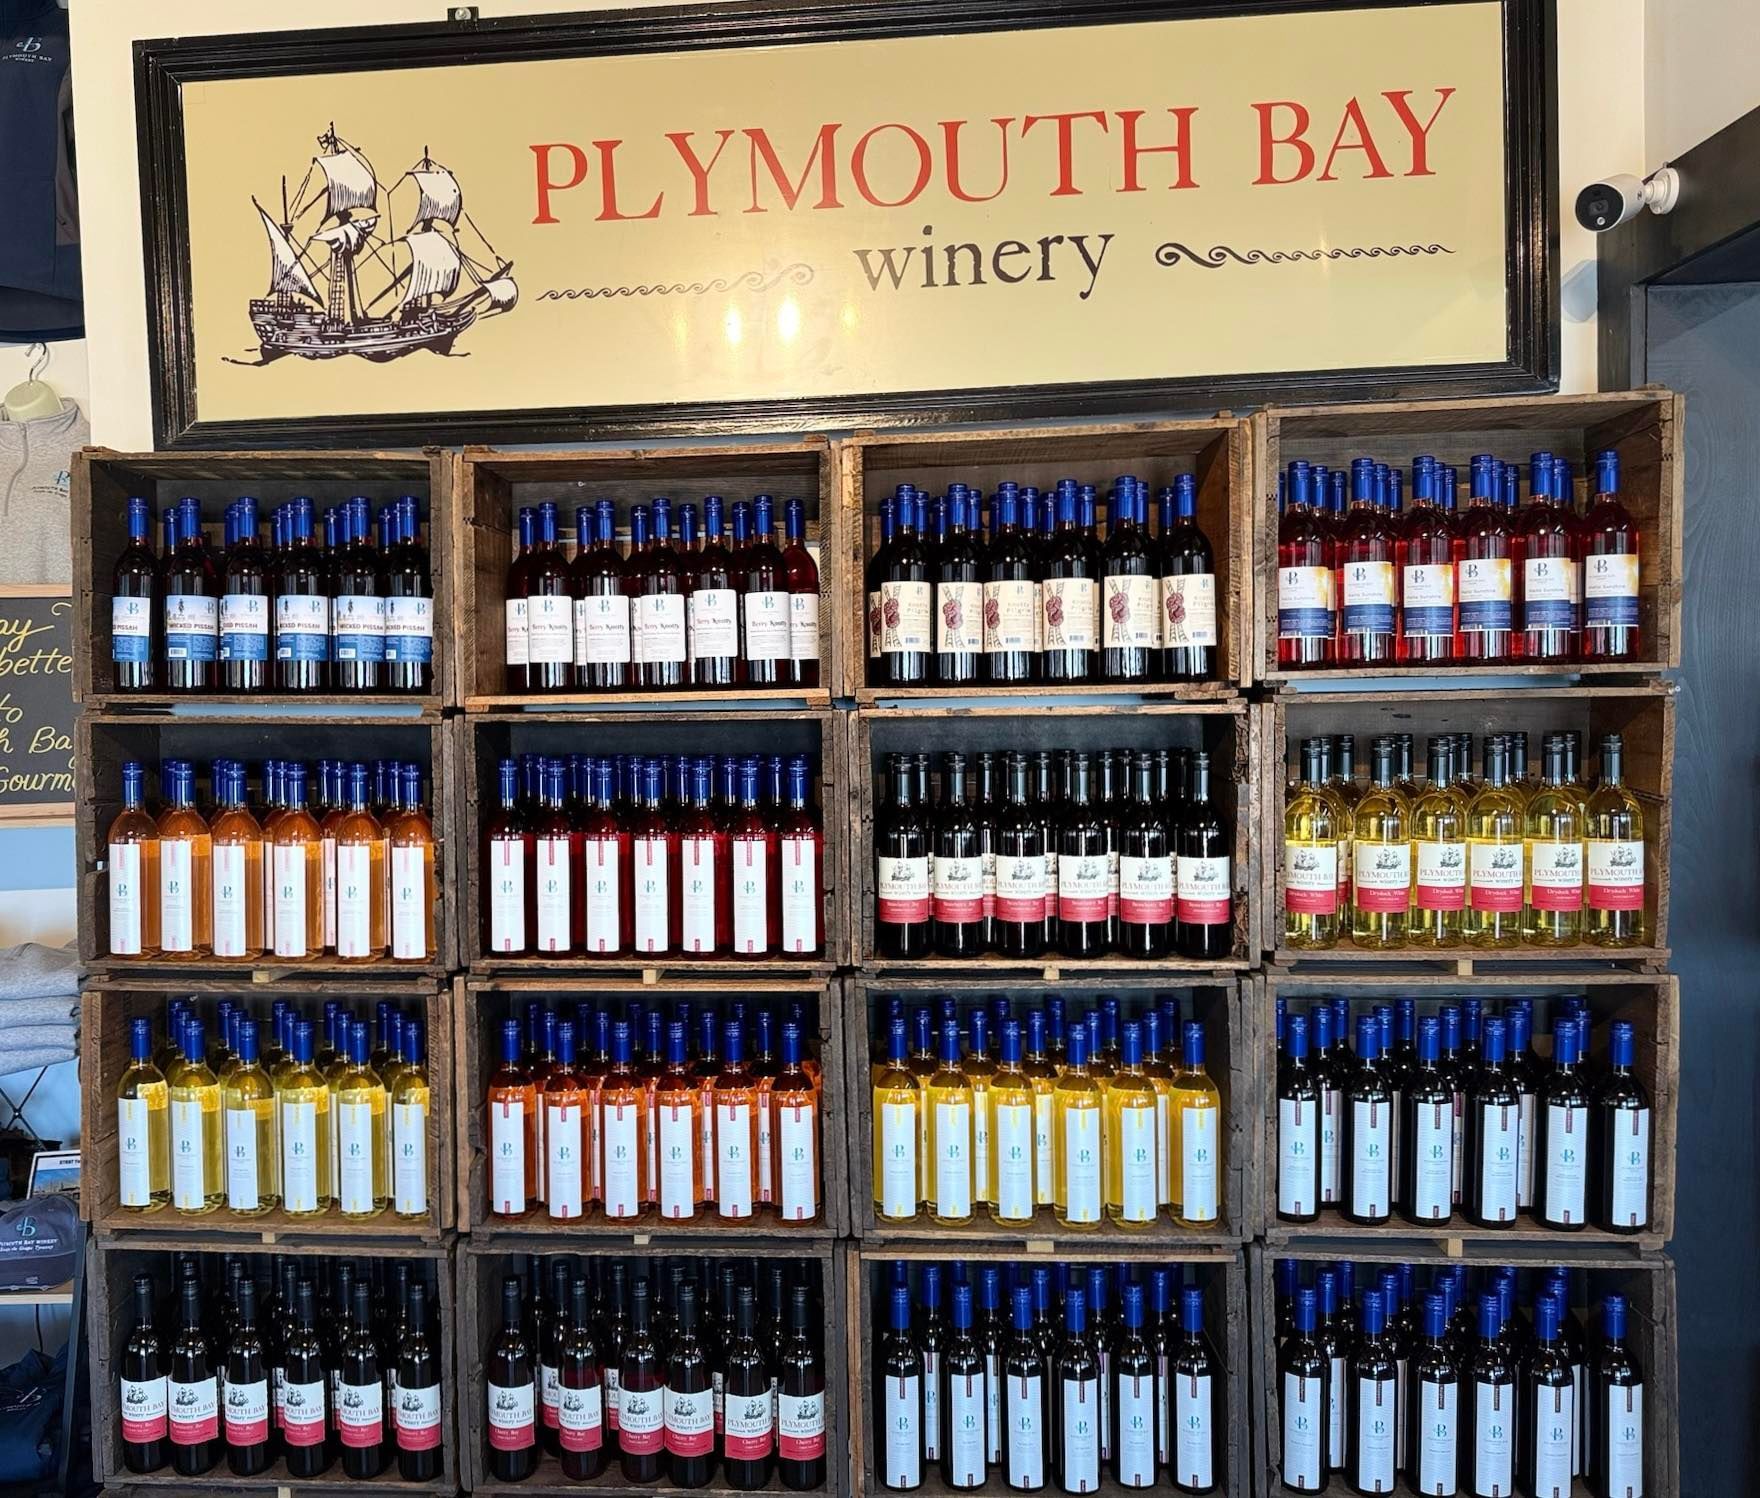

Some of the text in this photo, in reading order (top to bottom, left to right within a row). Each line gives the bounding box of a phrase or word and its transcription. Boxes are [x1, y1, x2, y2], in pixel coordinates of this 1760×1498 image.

[529, 87, 1456, 224] PLYMOUTH BAY
[852, 224, 1115, 300] winery
[0, 766, 75, 793] Gourm
